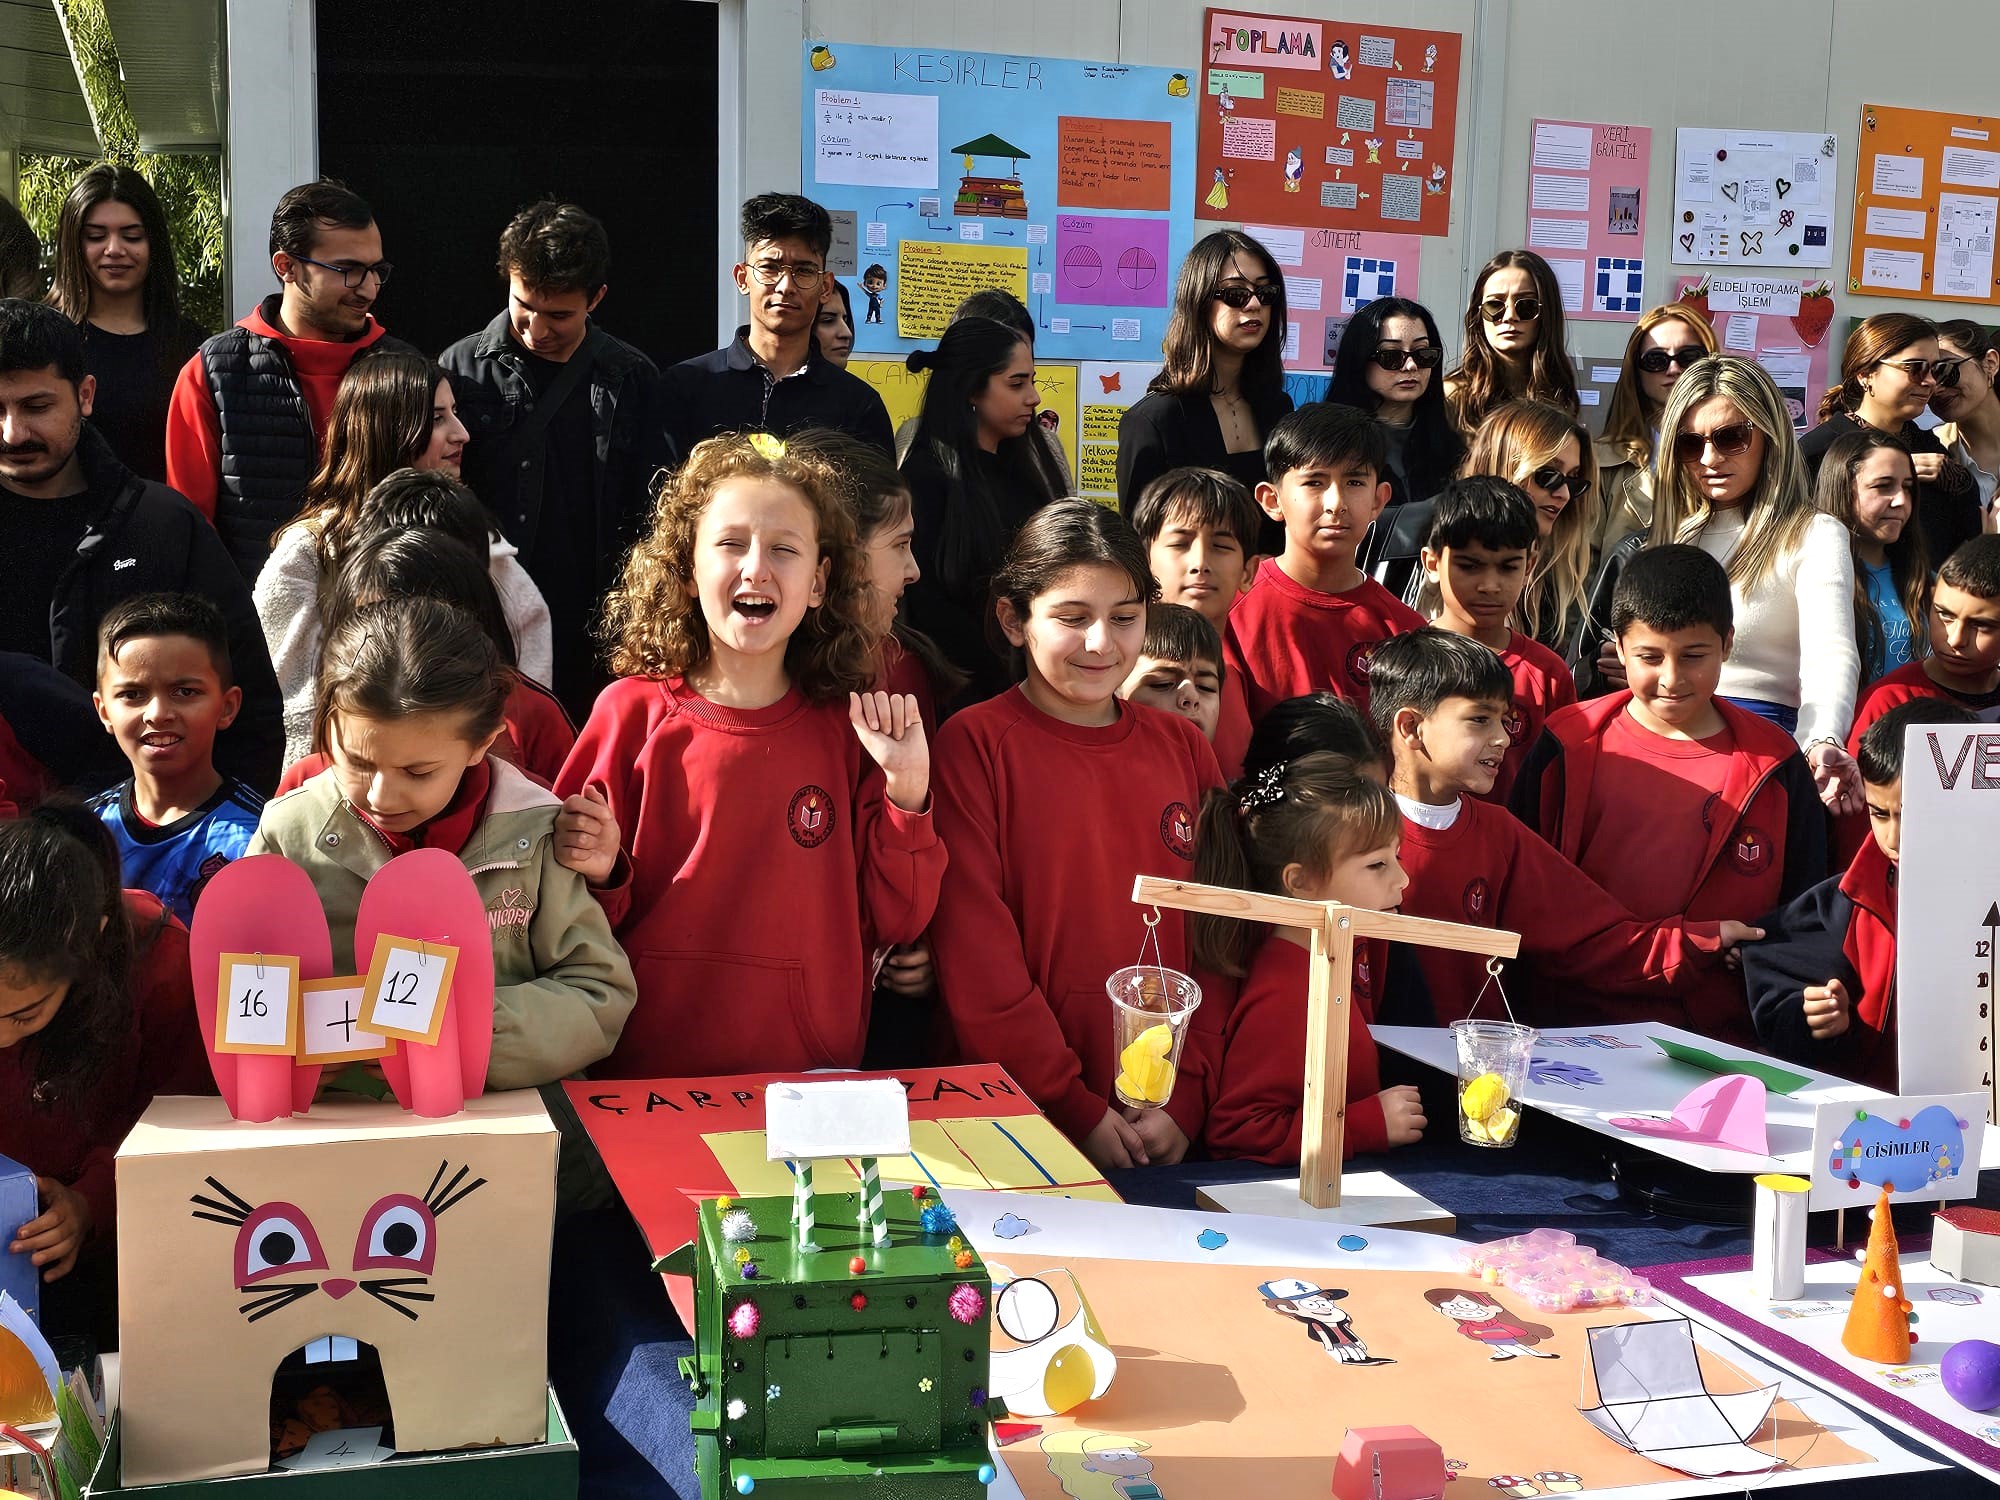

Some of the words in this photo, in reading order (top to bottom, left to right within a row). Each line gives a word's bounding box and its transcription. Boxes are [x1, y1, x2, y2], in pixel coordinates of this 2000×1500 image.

[1221, 27, 1316, 58] TOPLAMA
[894, 52, 1042, 90] KESİRLER
[821, 91, 852, 105] Problem
[1602, 125, 1630, 143] VERİ
[904, 241, 932, 253] Problem
[1311, 229, 1362, 251] SİMETRİ
[1712, 281, 1749, 294] ELDELİ
[1751, 282, 1800, 296] TOPLAMA
[1738, 294, 1772, 309] İŞLEMİ
[1082, 444, 1117, 457] Yelkova
[1975, 940, 1991, 958] 12
[1977, 972, 1989, 988] 10
[239, 988, 268, 1018] 16
[383, 970, 420, 1006] 12
[1979, 1003, 1988, 1019] 8
[1979, 1036, 1988, 1051] 6
[1982, 1072, 1992, 1087] 4
[588, 1090, 754, 1115] ÇARP
[901, 1078, 1017, 1102] ZAN
[1865, 1140, 1930, 1159] CİSİMLER
[325, 1440, 355, 1459] 4
